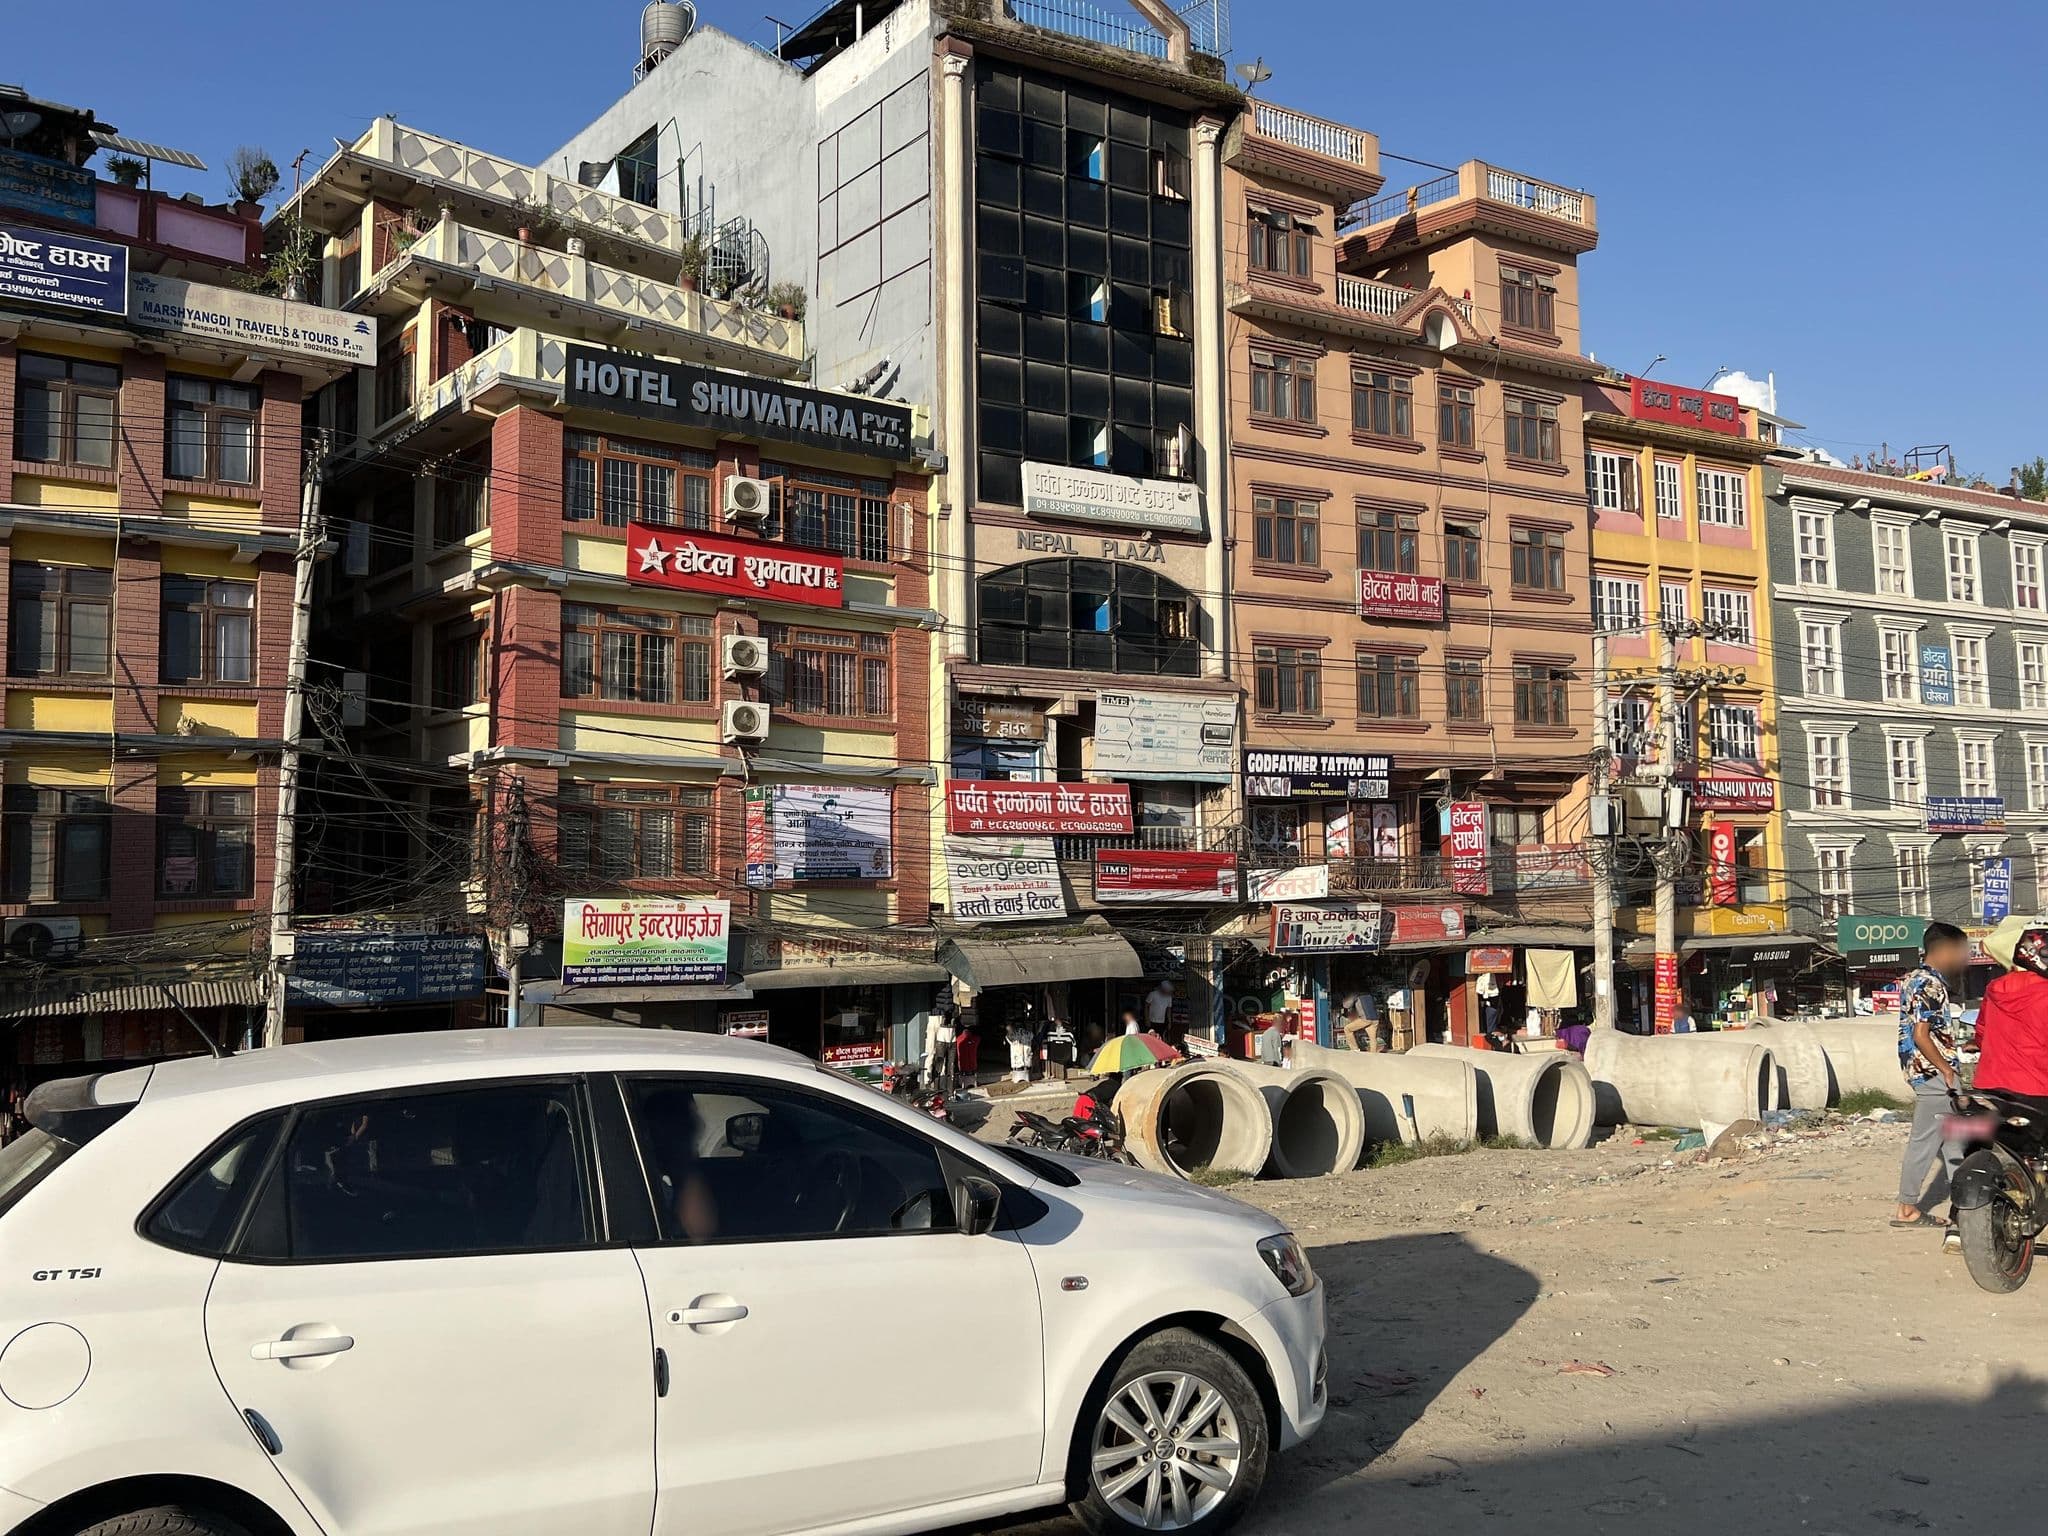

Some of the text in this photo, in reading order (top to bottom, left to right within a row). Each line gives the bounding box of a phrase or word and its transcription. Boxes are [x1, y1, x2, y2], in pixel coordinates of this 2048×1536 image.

[49, 245, 112, 272] हाउस
[143, 300, 231, 327] MARSHYANGDI
[235, 317, 290, 338] TRAVEL'S
[292, 329, 300, 339] &
[301, 330, 339, 347] TOURS
[343, 338, 352, 349] P.
[575, 357, 860, 440] HOTEL SHUVATARA
[862, 411, 905, 433] PVT.
[861, 428, 905, 450] LTD.
[1017, 530, 1166, 564] NEPAL PLAZA
[674, 540, 823, 588] होटल शुभतारा
[1362, 573, 1440, 607] होटल साथी भाई
[1922, 647, 1947, 664] होटल
[1247, 752, 1389, 777] GODFATHER TATTOO INN
[954, 784, 988, 814] पर्वत
[1056, 785, 1087, 815] गेष्ट
[1088, 792, 1128, 817] हाउस
[1698, 781, 1746, 797] TANAHUN
[1748, 781, 1773, 798] VYAS
[786, 819, 811, 828] आमा
[1452, 807, 1483, 828] होटल
[1453, 825, 1484, 852] साथी
[957, 859, 1051, 881] evergreen
[1104, 865, 1128, 876] IME
[1985, 868, 2009, 878] HOTEL
[1986, 878, 2009, 889] YETI
[956, 891, 1062, 917] सस्तो हवाई टिकट
[1279, 908, 1294, 922] डि
[581, 903, 723, 945] सिंगापुर इन्टरप्राइजेज
[1731, 913, 1766, 925] realme
[1752, 950, 1791, 961] SAMSUNG
[1869, 953, 1900, 963] SAMSUNG
[32, 1267, 102, 1281] GT TSI
